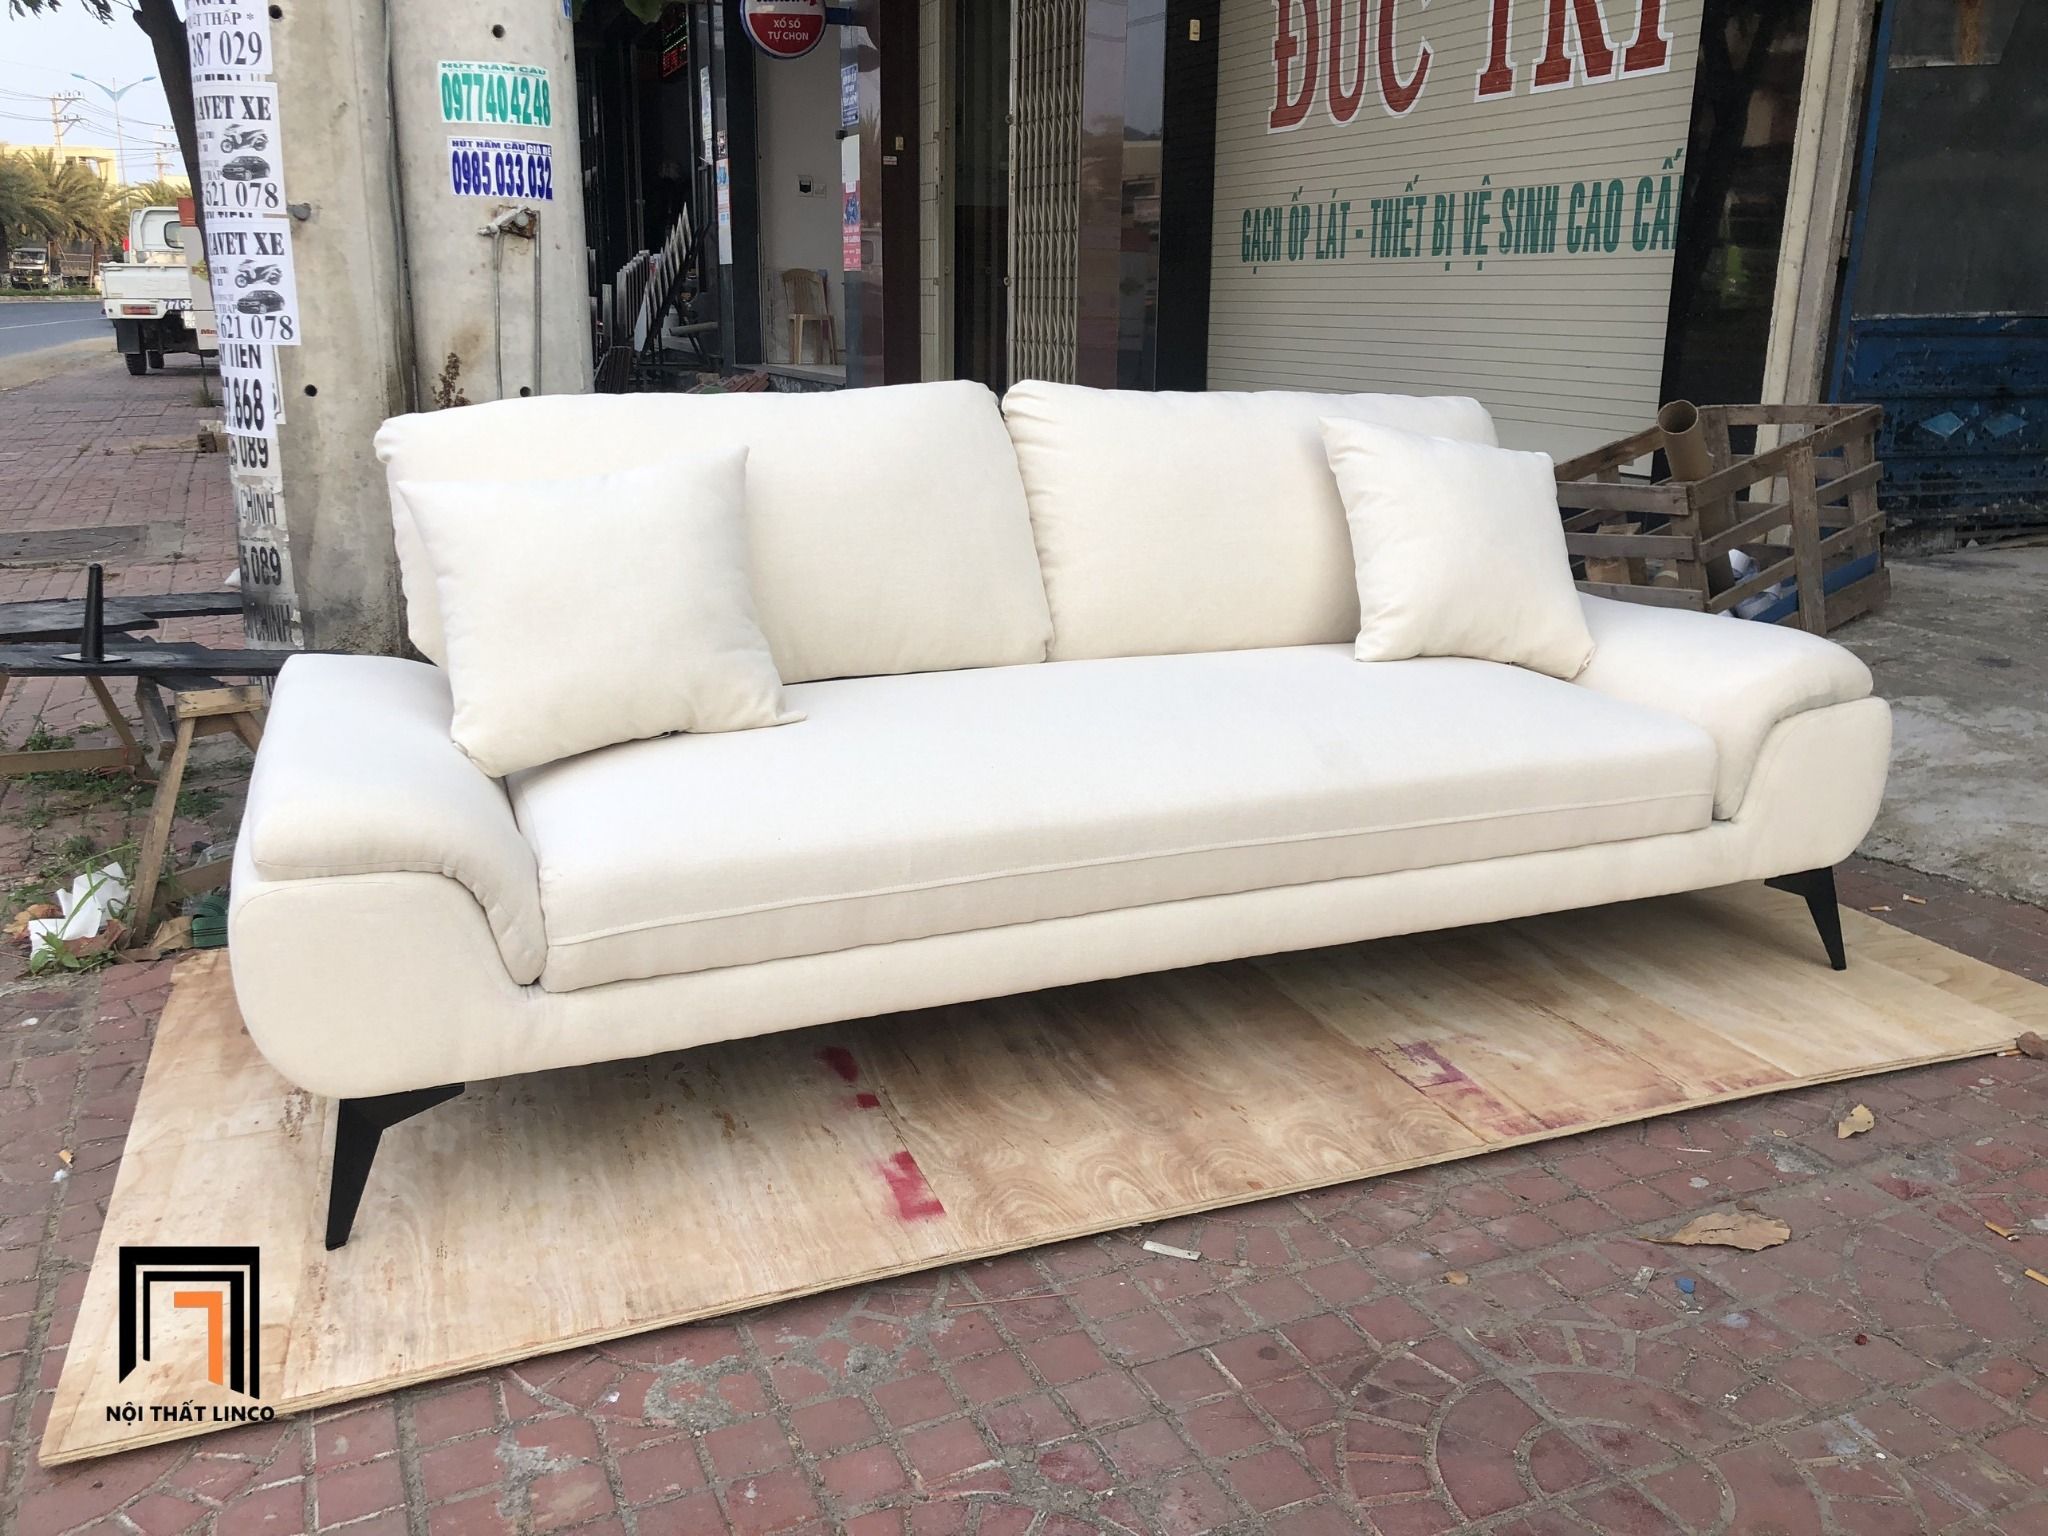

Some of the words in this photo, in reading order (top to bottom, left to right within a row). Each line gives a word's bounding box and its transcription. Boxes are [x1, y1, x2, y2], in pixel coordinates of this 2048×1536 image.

[219, 30, 262, 66] 029
[196, 95, 235, 120] AVET
[240, 95, 272, 120] XE
[441, 72, 551, 127] 0977.40.42.48
[452, 150, 553, 200] 0985.033.032
[235, 181, 279, 208] 078
[1241, 206, 1283, 275] GẠCH
[1288, 186, 1311, 261] ỐP
[1315, 187, 1352, 260] LÁT
[1370, 174, 1428, 258] THIẾT
[1431, 192, 1456, 272] BỊ
[1462, 175, 1492, 272] VỆ
[1498, 185, 1560, 255] SINH
[1566, 178, 1624, 254] CAO
[253, 231, 285, 256] XE
[251, 314, 294, 341] 078
[233, 376, 265, 432] 868
